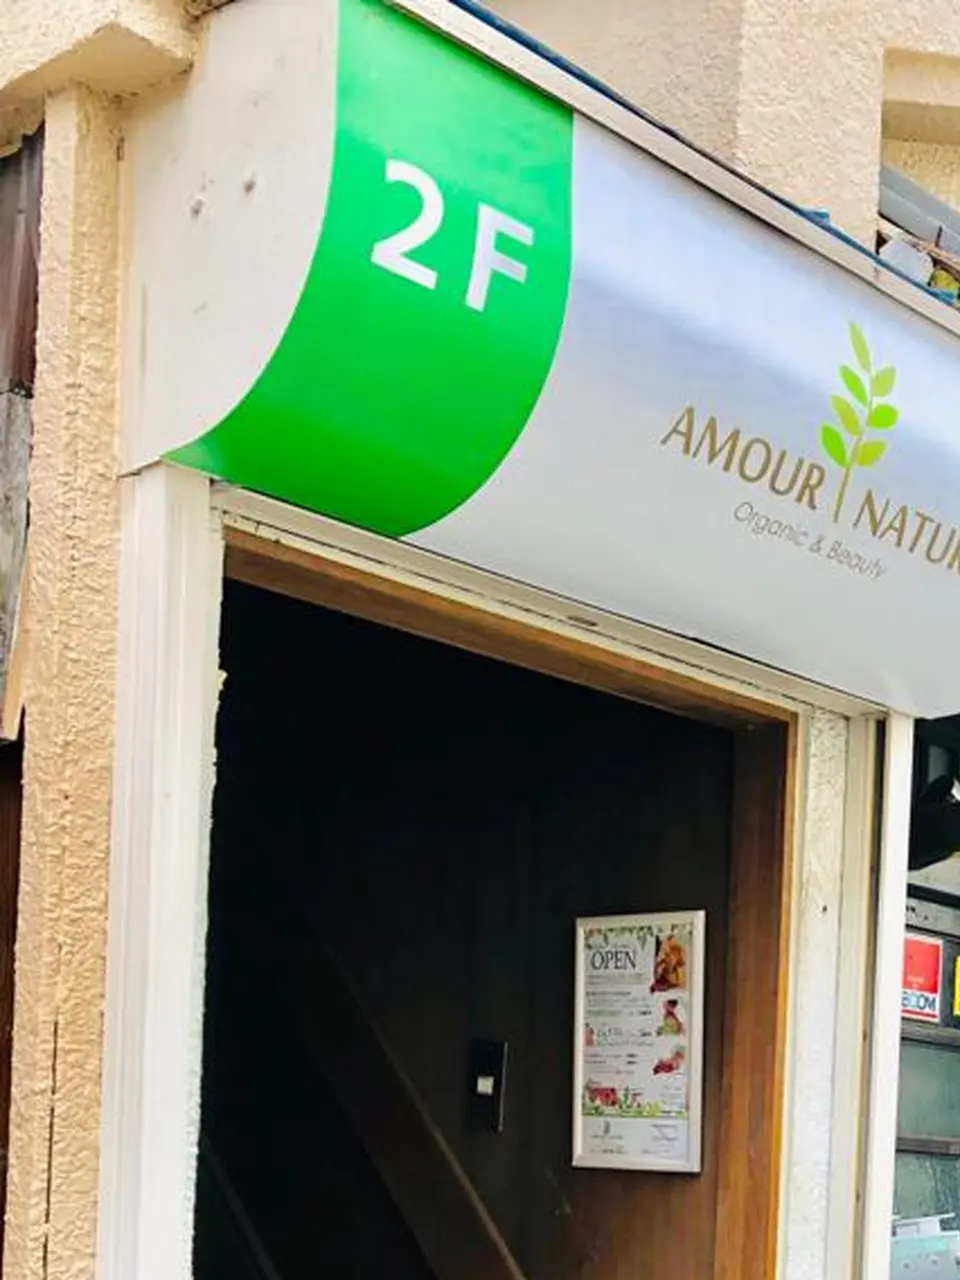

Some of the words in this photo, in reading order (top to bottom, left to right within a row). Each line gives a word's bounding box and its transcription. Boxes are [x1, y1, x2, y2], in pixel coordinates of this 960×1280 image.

[368, 158, 535, 313] 2F
[660, 405, 827, 512] AMOUR
[733, 501, 809, 547] Organic
[808, 534, 827, 554] &
[826, 540, 888, 581] Beauty
[590, 949, 637, 971] OPEN
